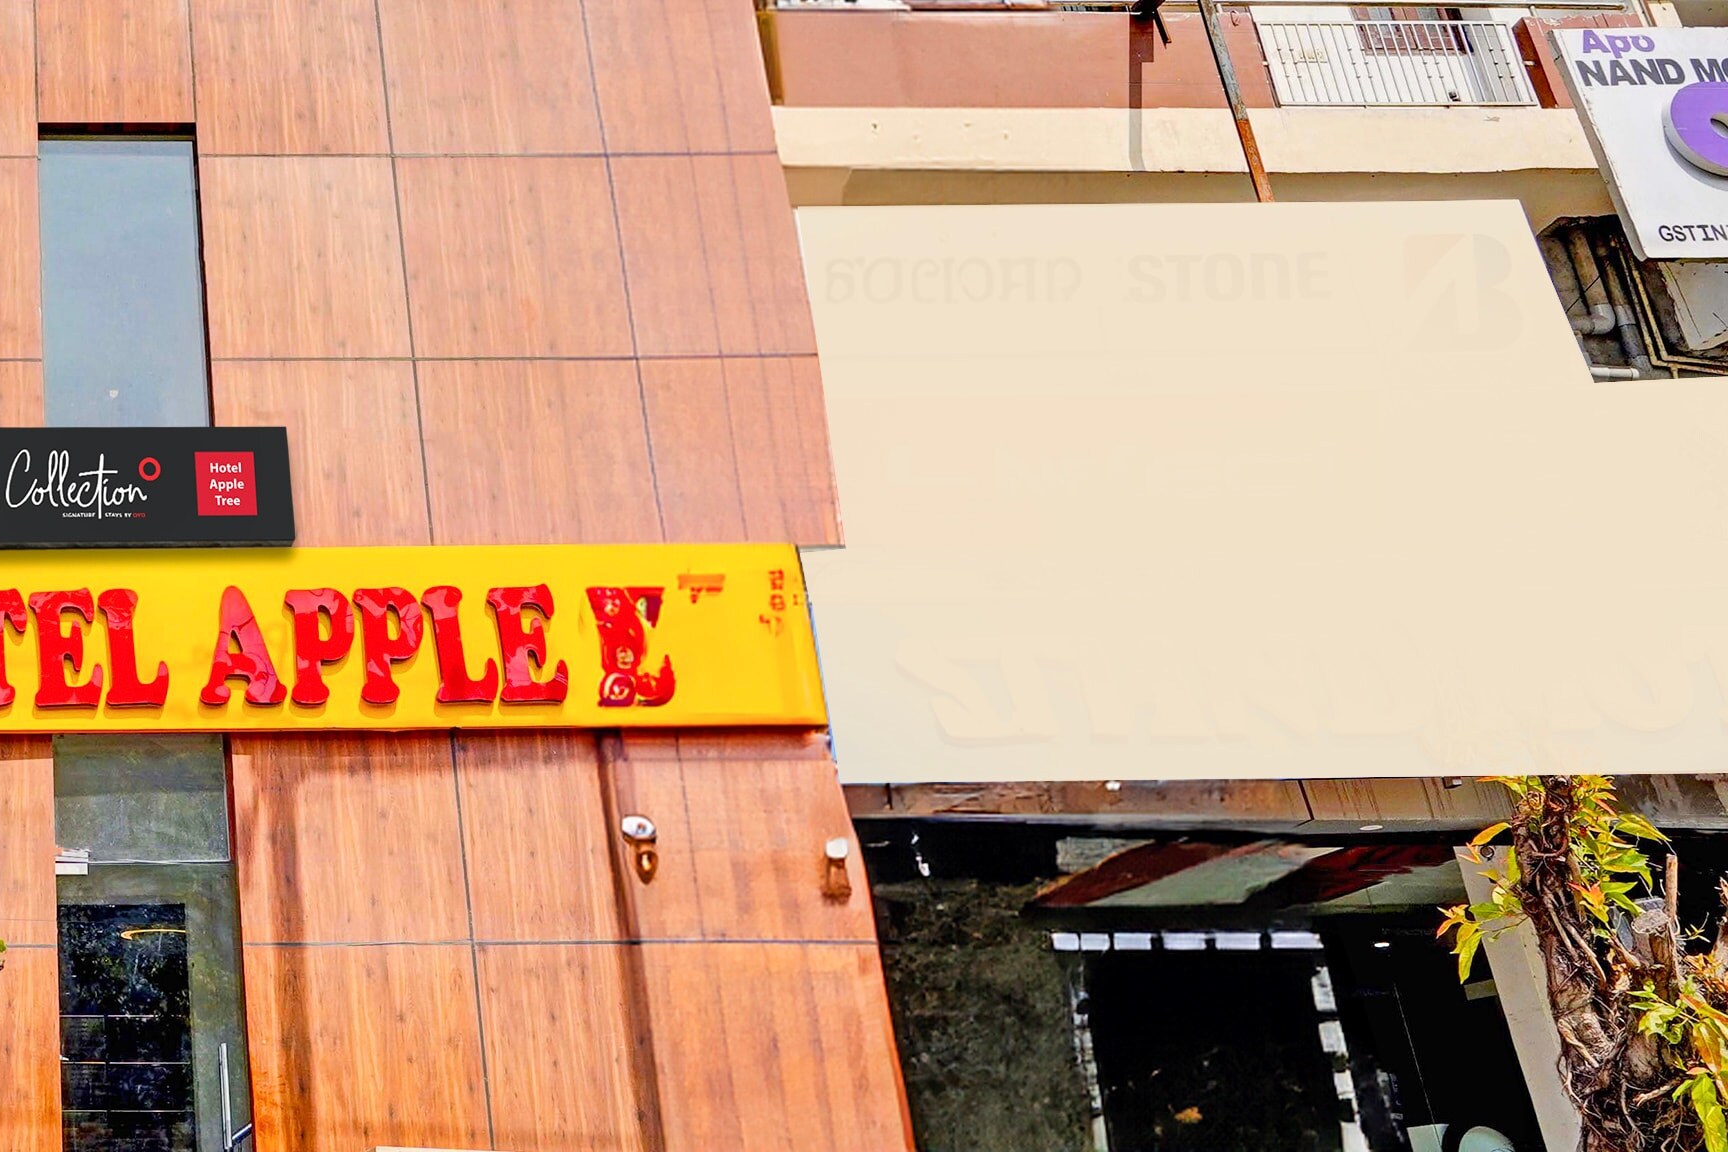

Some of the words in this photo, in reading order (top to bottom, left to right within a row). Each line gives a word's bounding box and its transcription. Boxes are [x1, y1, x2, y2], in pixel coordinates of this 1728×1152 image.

[1575, 58, 1686, 87] NAND
[1689, 58, 1728, 85] M
[209, 461, 242, 473] Hotel
[5, 448, 148, 520] Collection
[209, 478, 245, 492] Apple
[214, 495, 241, 506] Tree
[198, 582, 569, 706] APPLE
